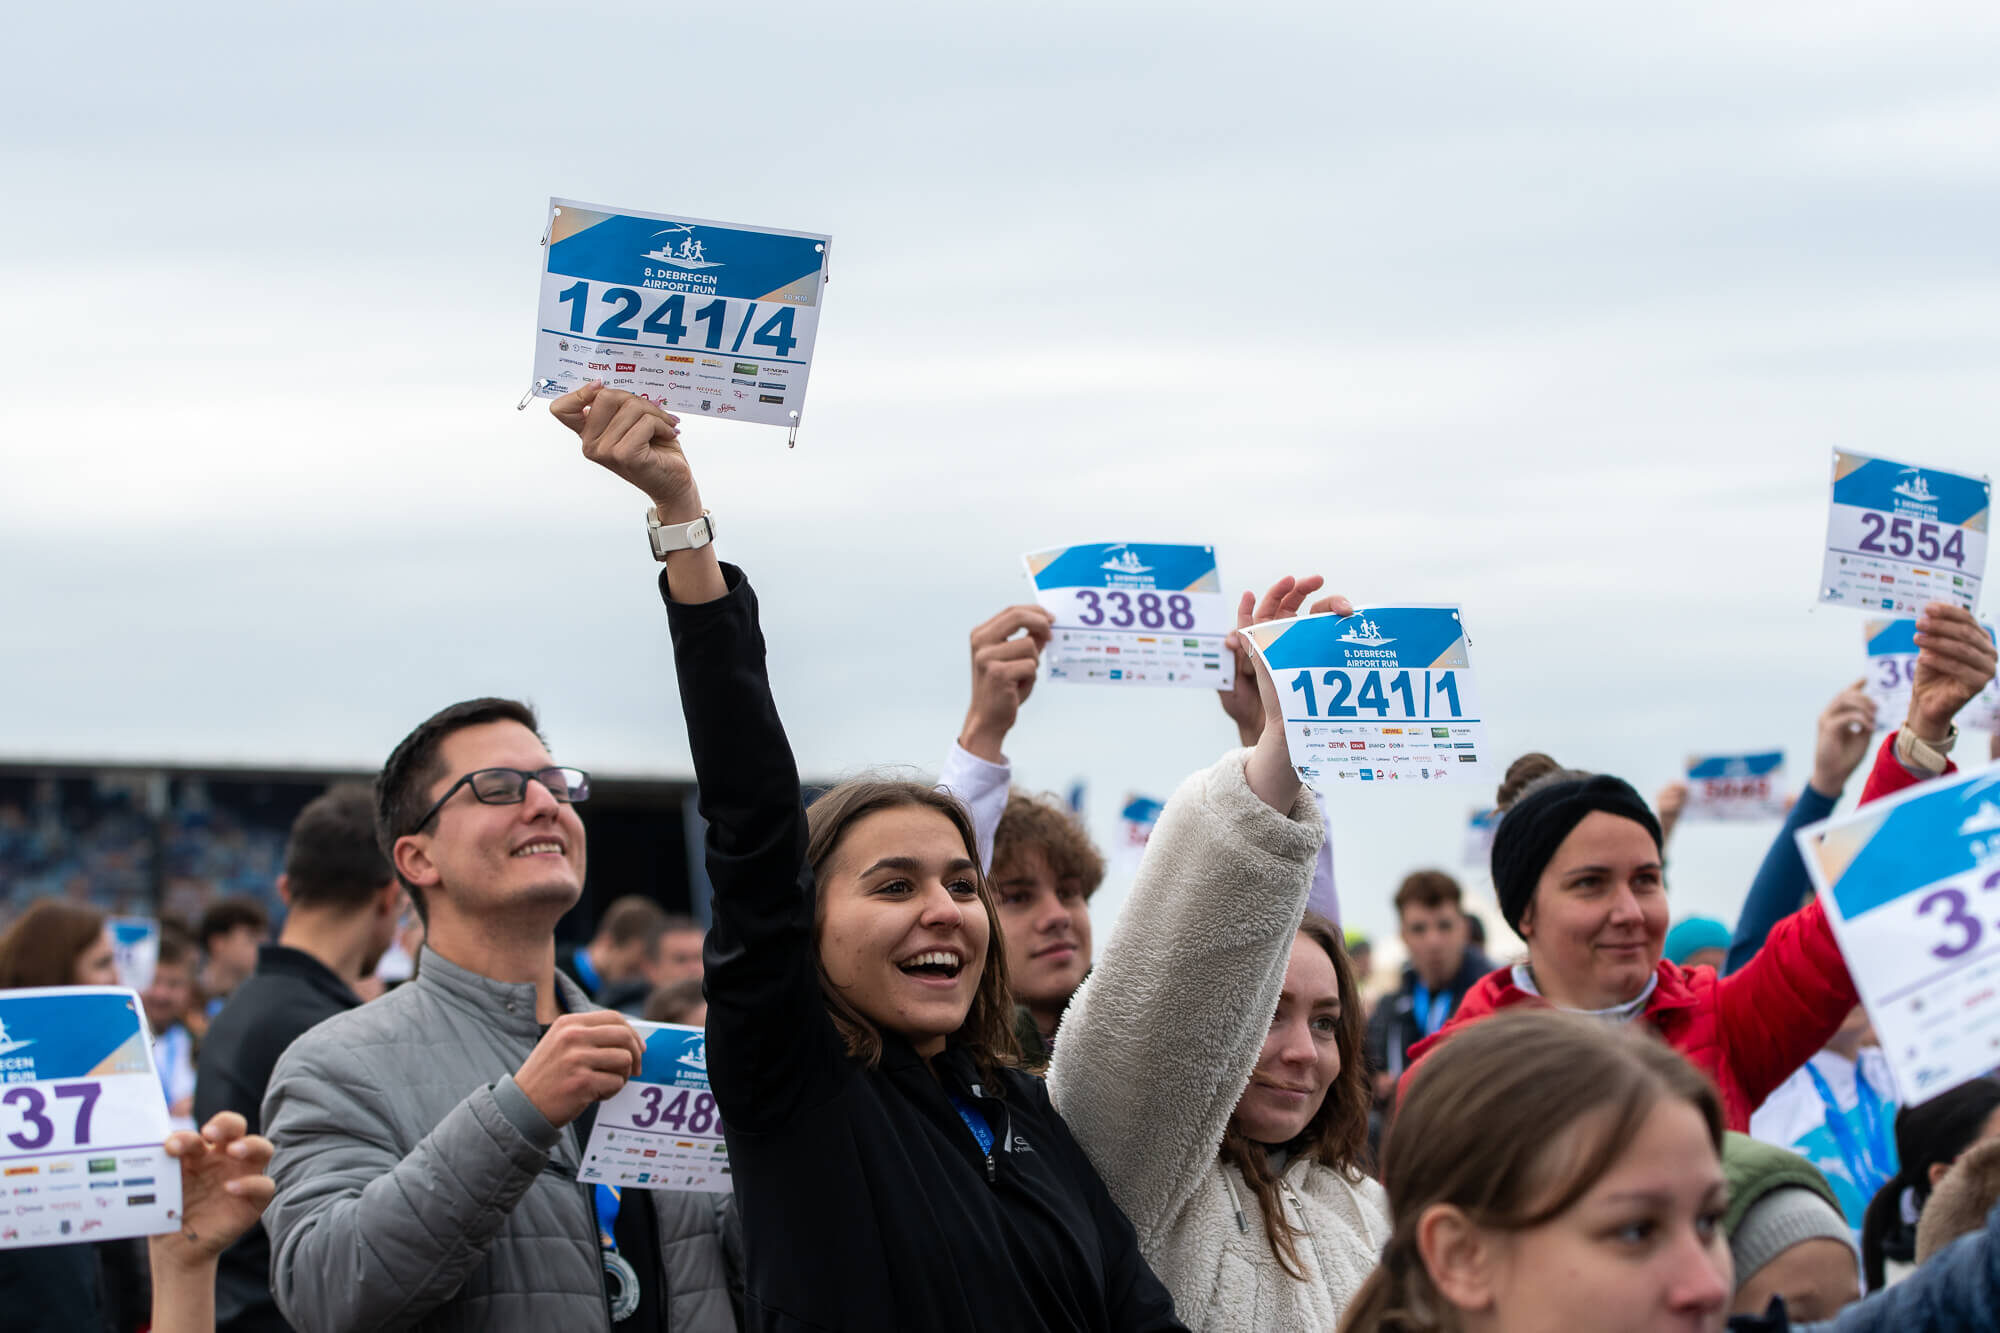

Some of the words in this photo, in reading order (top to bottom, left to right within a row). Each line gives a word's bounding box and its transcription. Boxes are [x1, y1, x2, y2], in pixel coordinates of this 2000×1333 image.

[642, 279, 691, 292] AIRPORT
[692, 285, 716, 295] RUN
[644, 267, 655, 278] 8.
[657, 269, 718, 285] DEBRECEN
[558, 281, 797, 356] 1241/4
[1859, 513, 1965, 568] 2554
[1075, 590, 1195, 630] 3388
[1344, 649, 1353, 658] 8.
[1354, 650, 1397, 658] DEBRECEN
[1346, 659, 1380, 667] AIRPORT
[1381, 660, 1399, 668] RUN
[1291, 670, 1462, 718] 1241/1
[2, 1082, 102, 1151] 37
